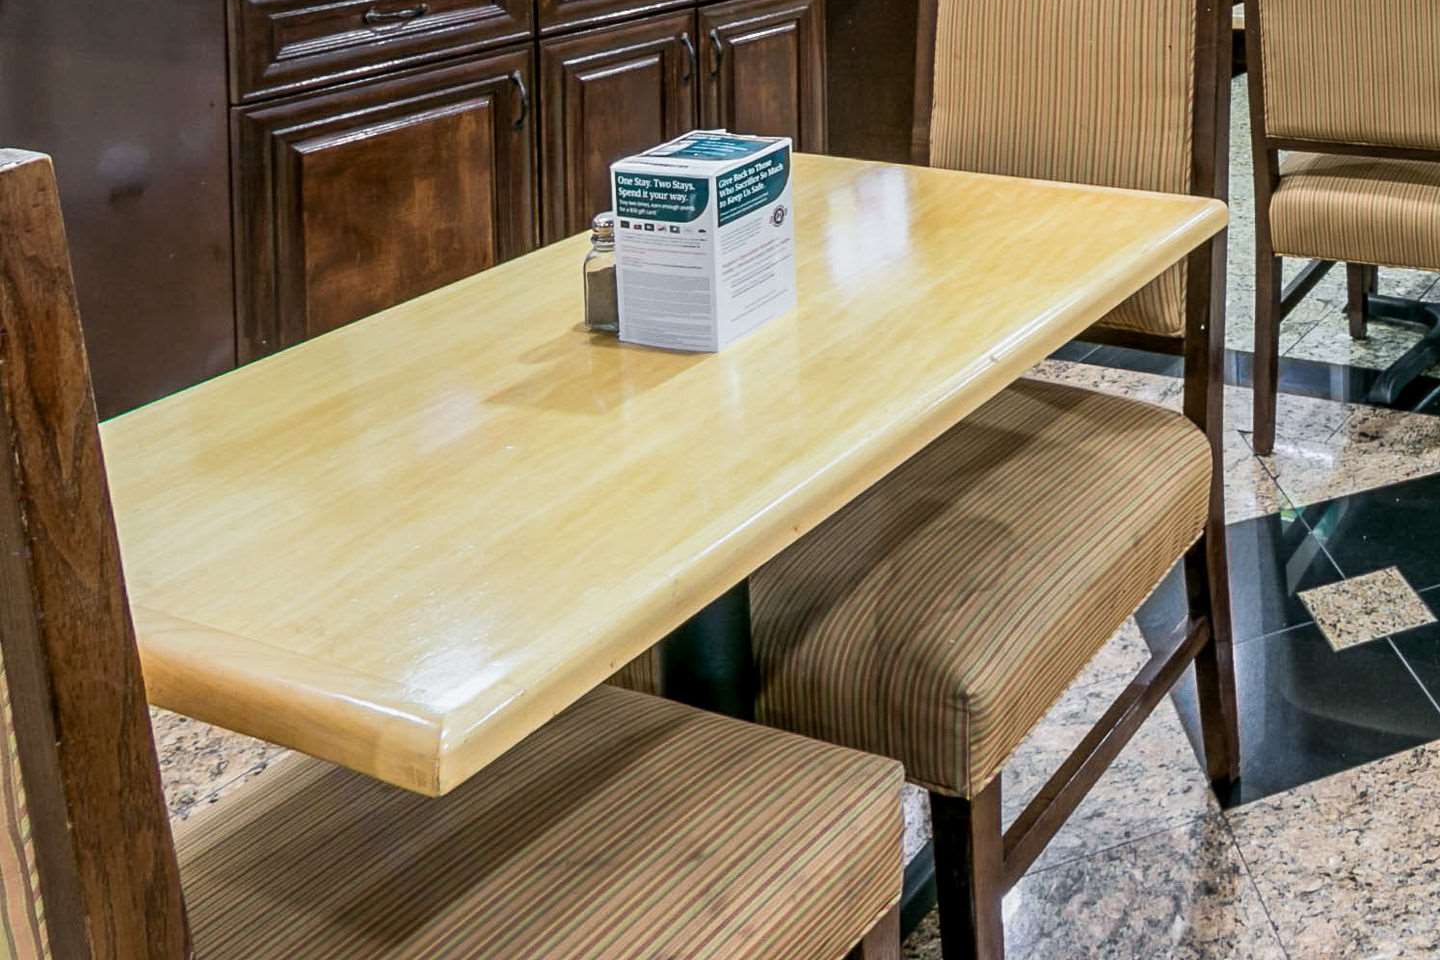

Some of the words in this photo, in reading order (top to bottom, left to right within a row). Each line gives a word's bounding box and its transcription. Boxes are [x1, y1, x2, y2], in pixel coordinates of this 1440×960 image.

[617, 175, 633, 185] One
[634, 177, 651, 188] Stay.
[653, 178, 672, 189] Two
[672, 180, 696, 192] Stays.
[618, 187, 641, 198] Spend
[642, 189, 648, 198] it
[649, 192, 669, 201] your
[669, 194, 689, 204] way.
